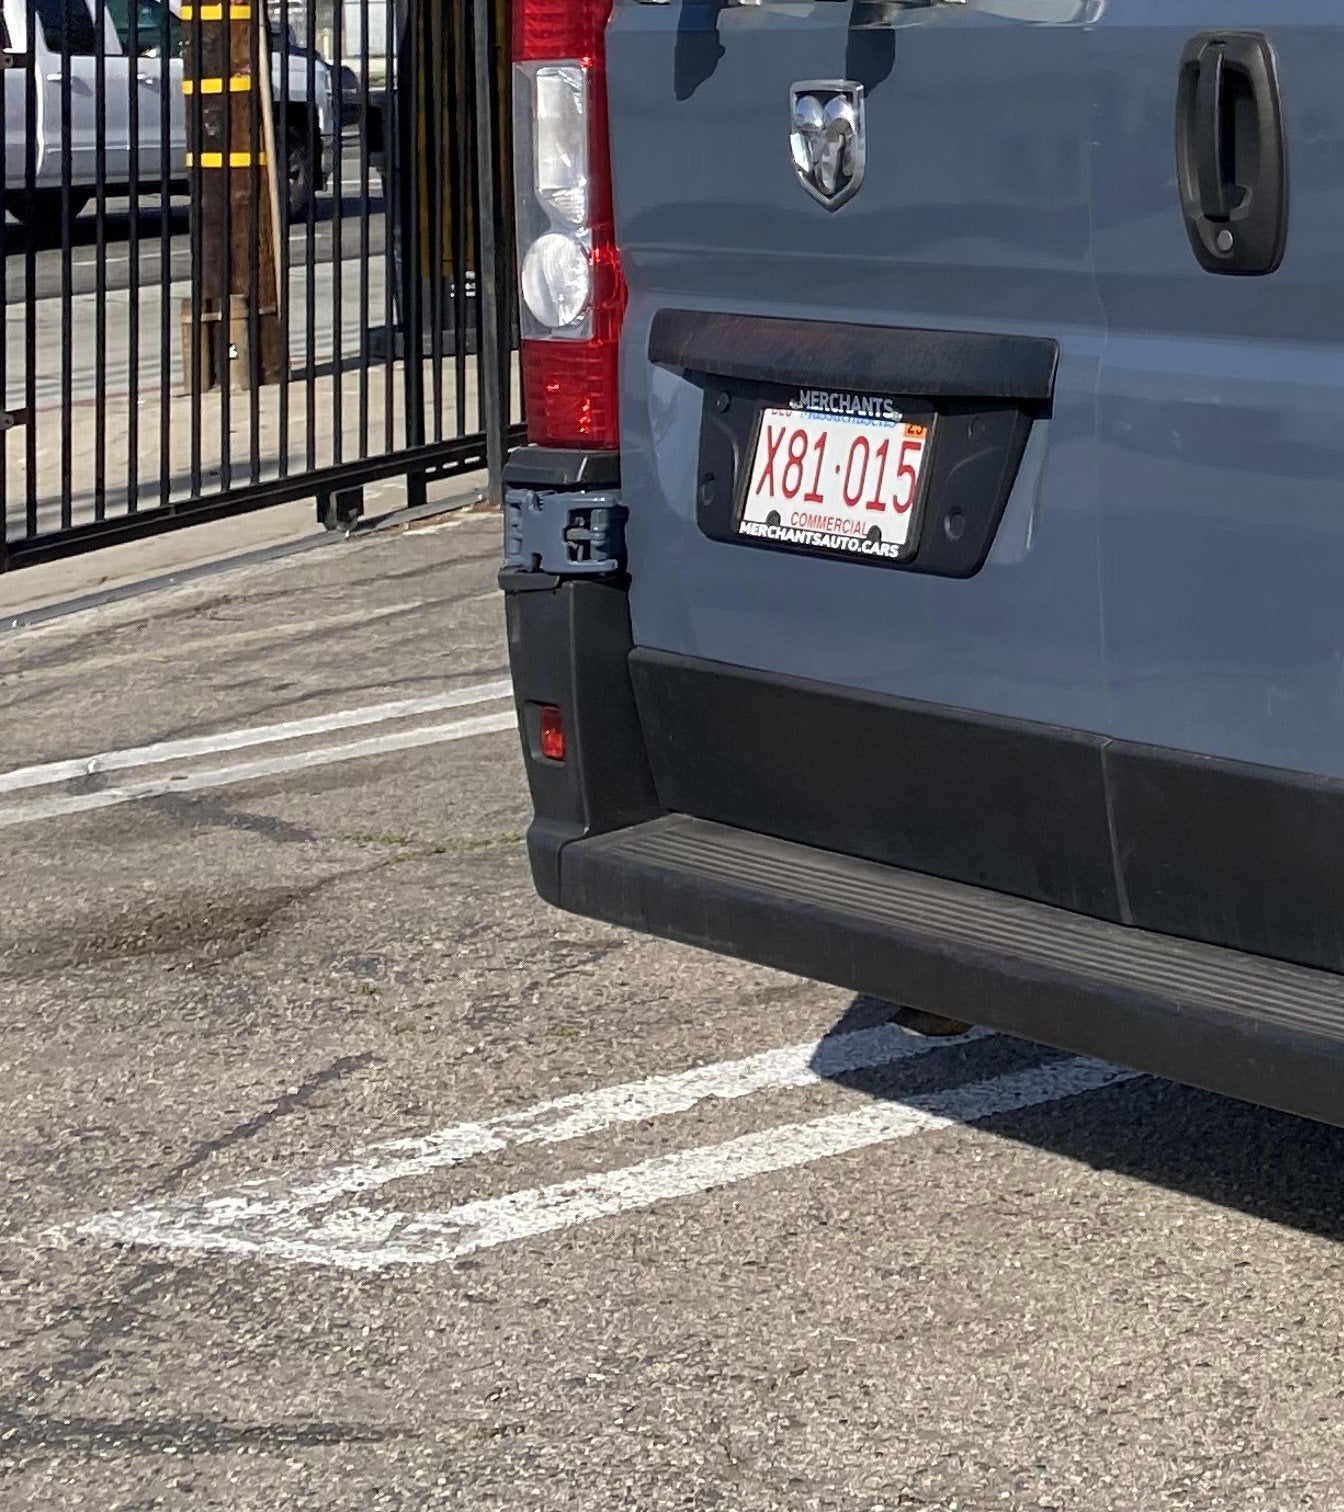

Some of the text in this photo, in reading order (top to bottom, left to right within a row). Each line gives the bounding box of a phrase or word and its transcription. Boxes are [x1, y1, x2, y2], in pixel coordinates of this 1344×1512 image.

[799, 388, 896, 418] MERCHANTS
[790, 511, 867, 536] COMMERCIAL
[738, 520, 900, 558] MERCHANTSAUTO.CARS
